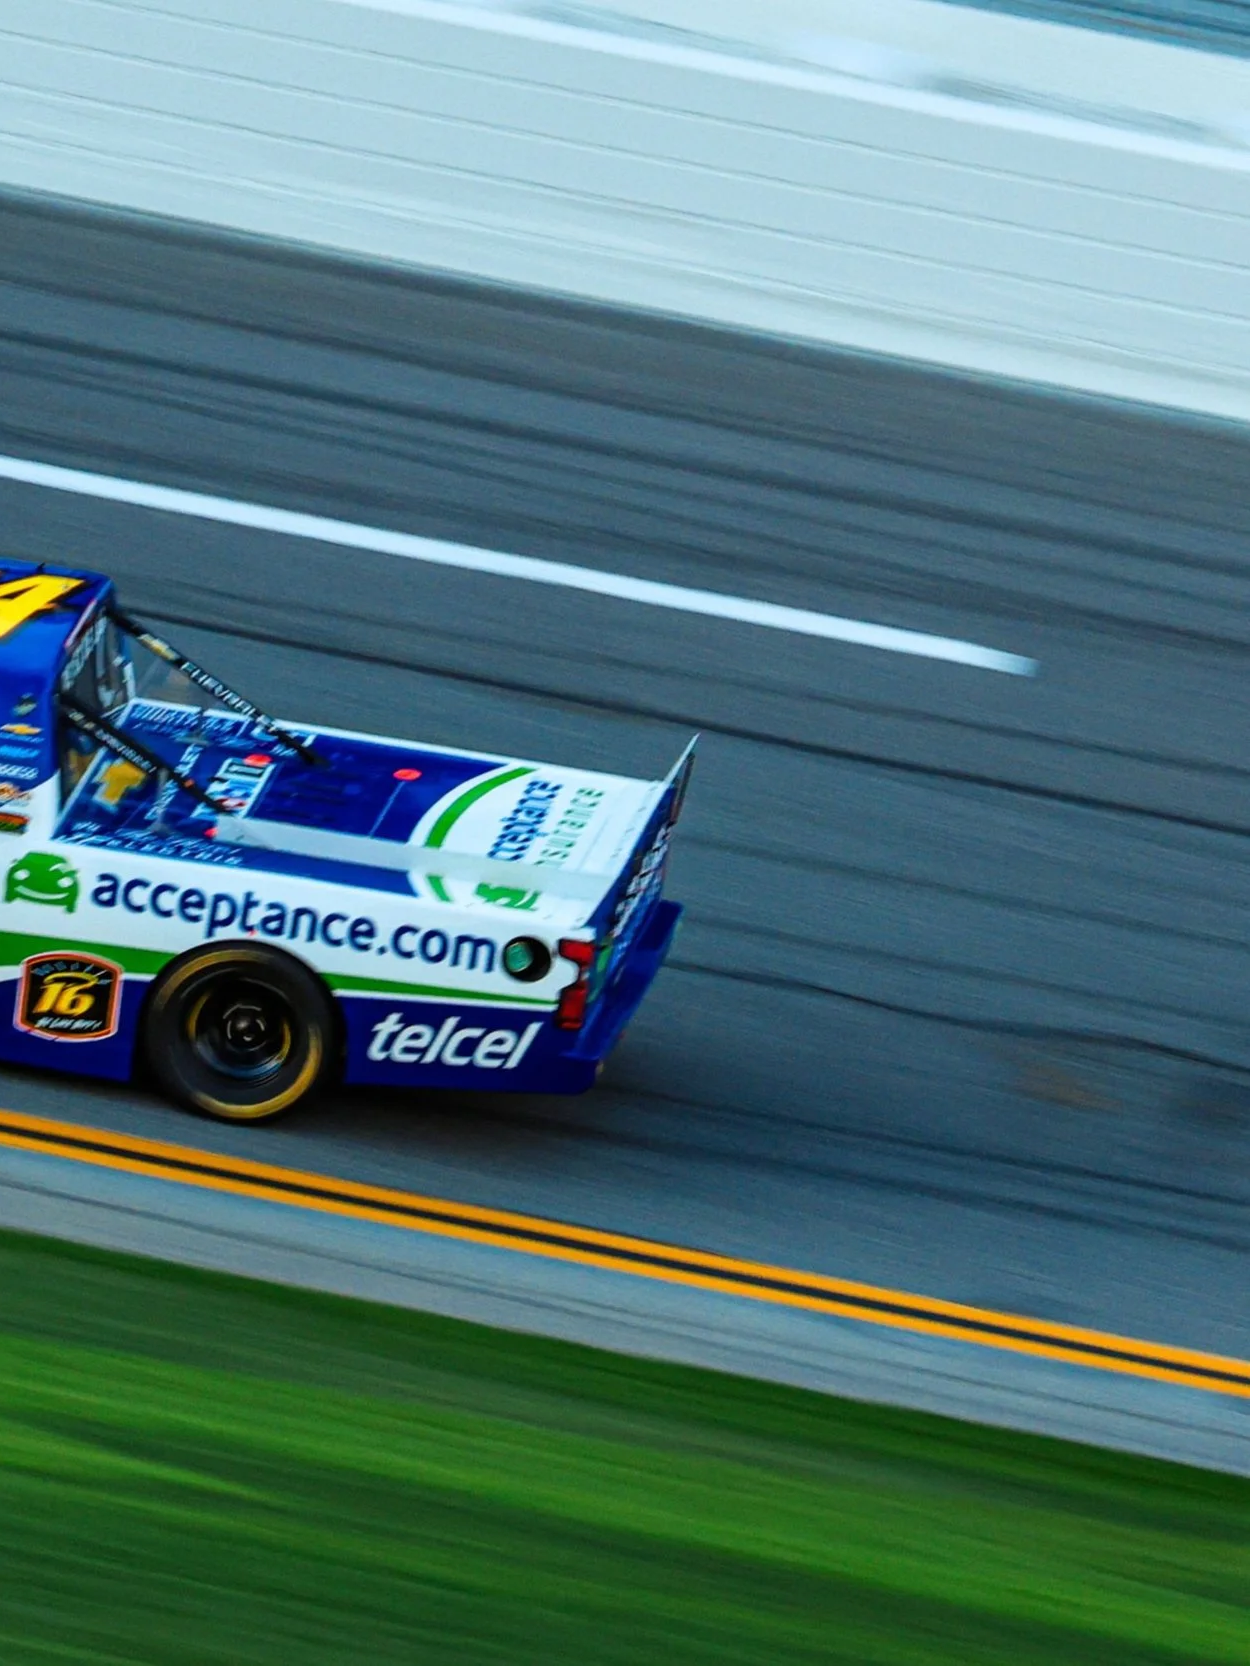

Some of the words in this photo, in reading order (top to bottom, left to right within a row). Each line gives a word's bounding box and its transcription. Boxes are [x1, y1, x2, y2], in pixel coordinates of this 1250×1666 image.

[487, 781, 563, 861] cceptance
[92, 872, 495, 973] acceptance.com
[32, 972, 99, 1017] 16
[366, 1012, 545, 1070] telcel
